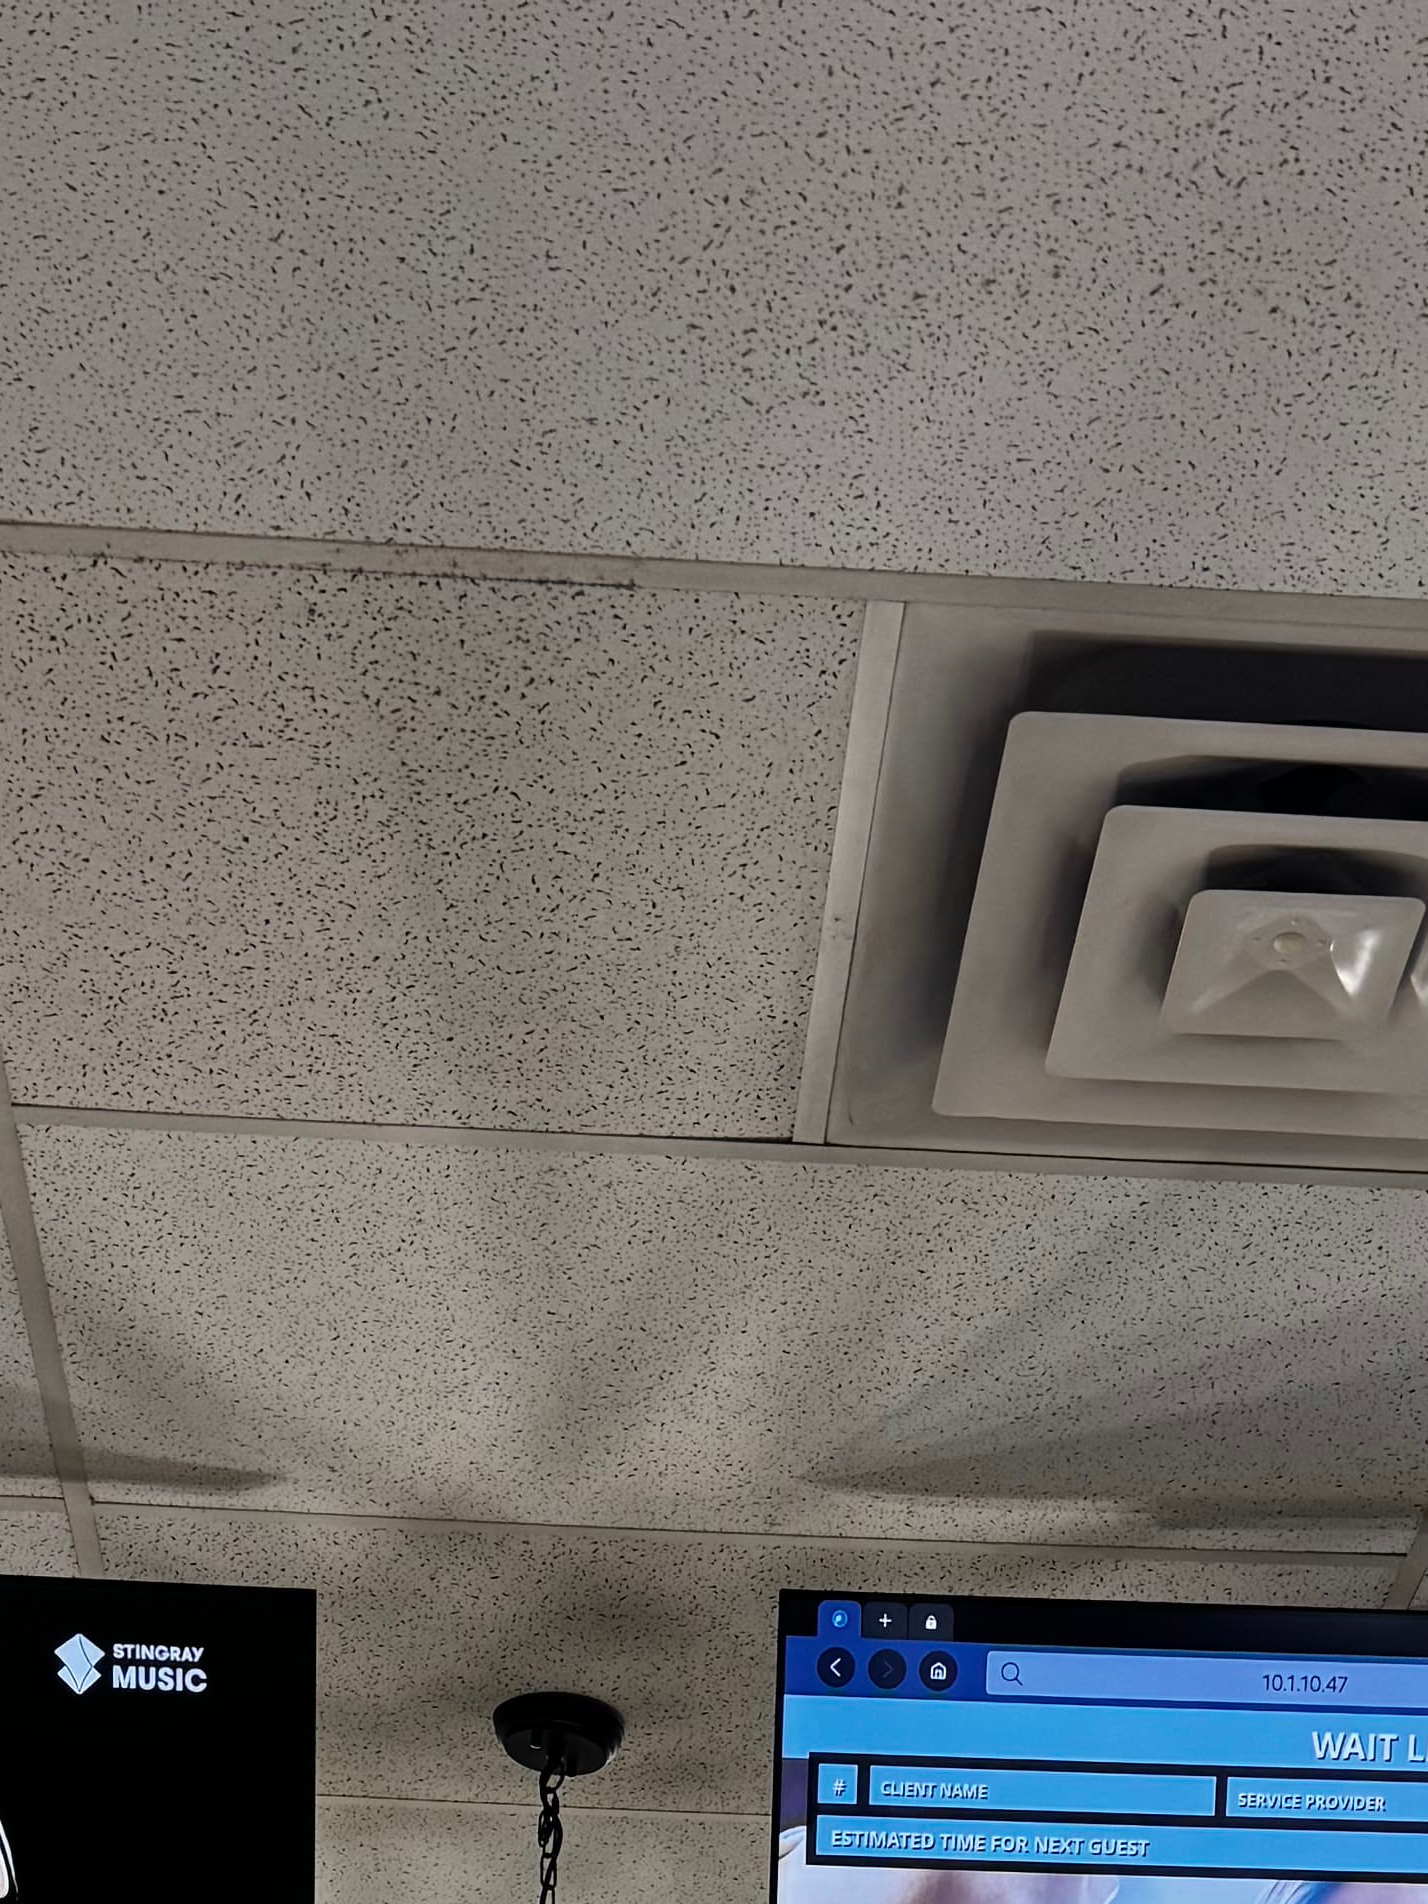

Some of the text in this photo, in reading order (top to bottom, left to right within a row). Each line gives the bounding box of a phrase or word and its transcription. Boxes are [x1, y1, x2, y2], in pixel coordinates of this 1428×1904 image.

[112, 1643, 204, 1663] STINGRAY
[112, 1665, 207, 1692] MUSIC
[1262, 1674, 1348, 1693] 10.1.10.47
[1312, 1731, 1399, 1762] WAIT
[881, 1781, 988, 1800] CLIENT NAME
[1238, 1792, 1387, 1812] SERVICE PROVIDER
[831, 1830, 1150, 1857] ESTIMATED TIME FOR NEXT GUEST
